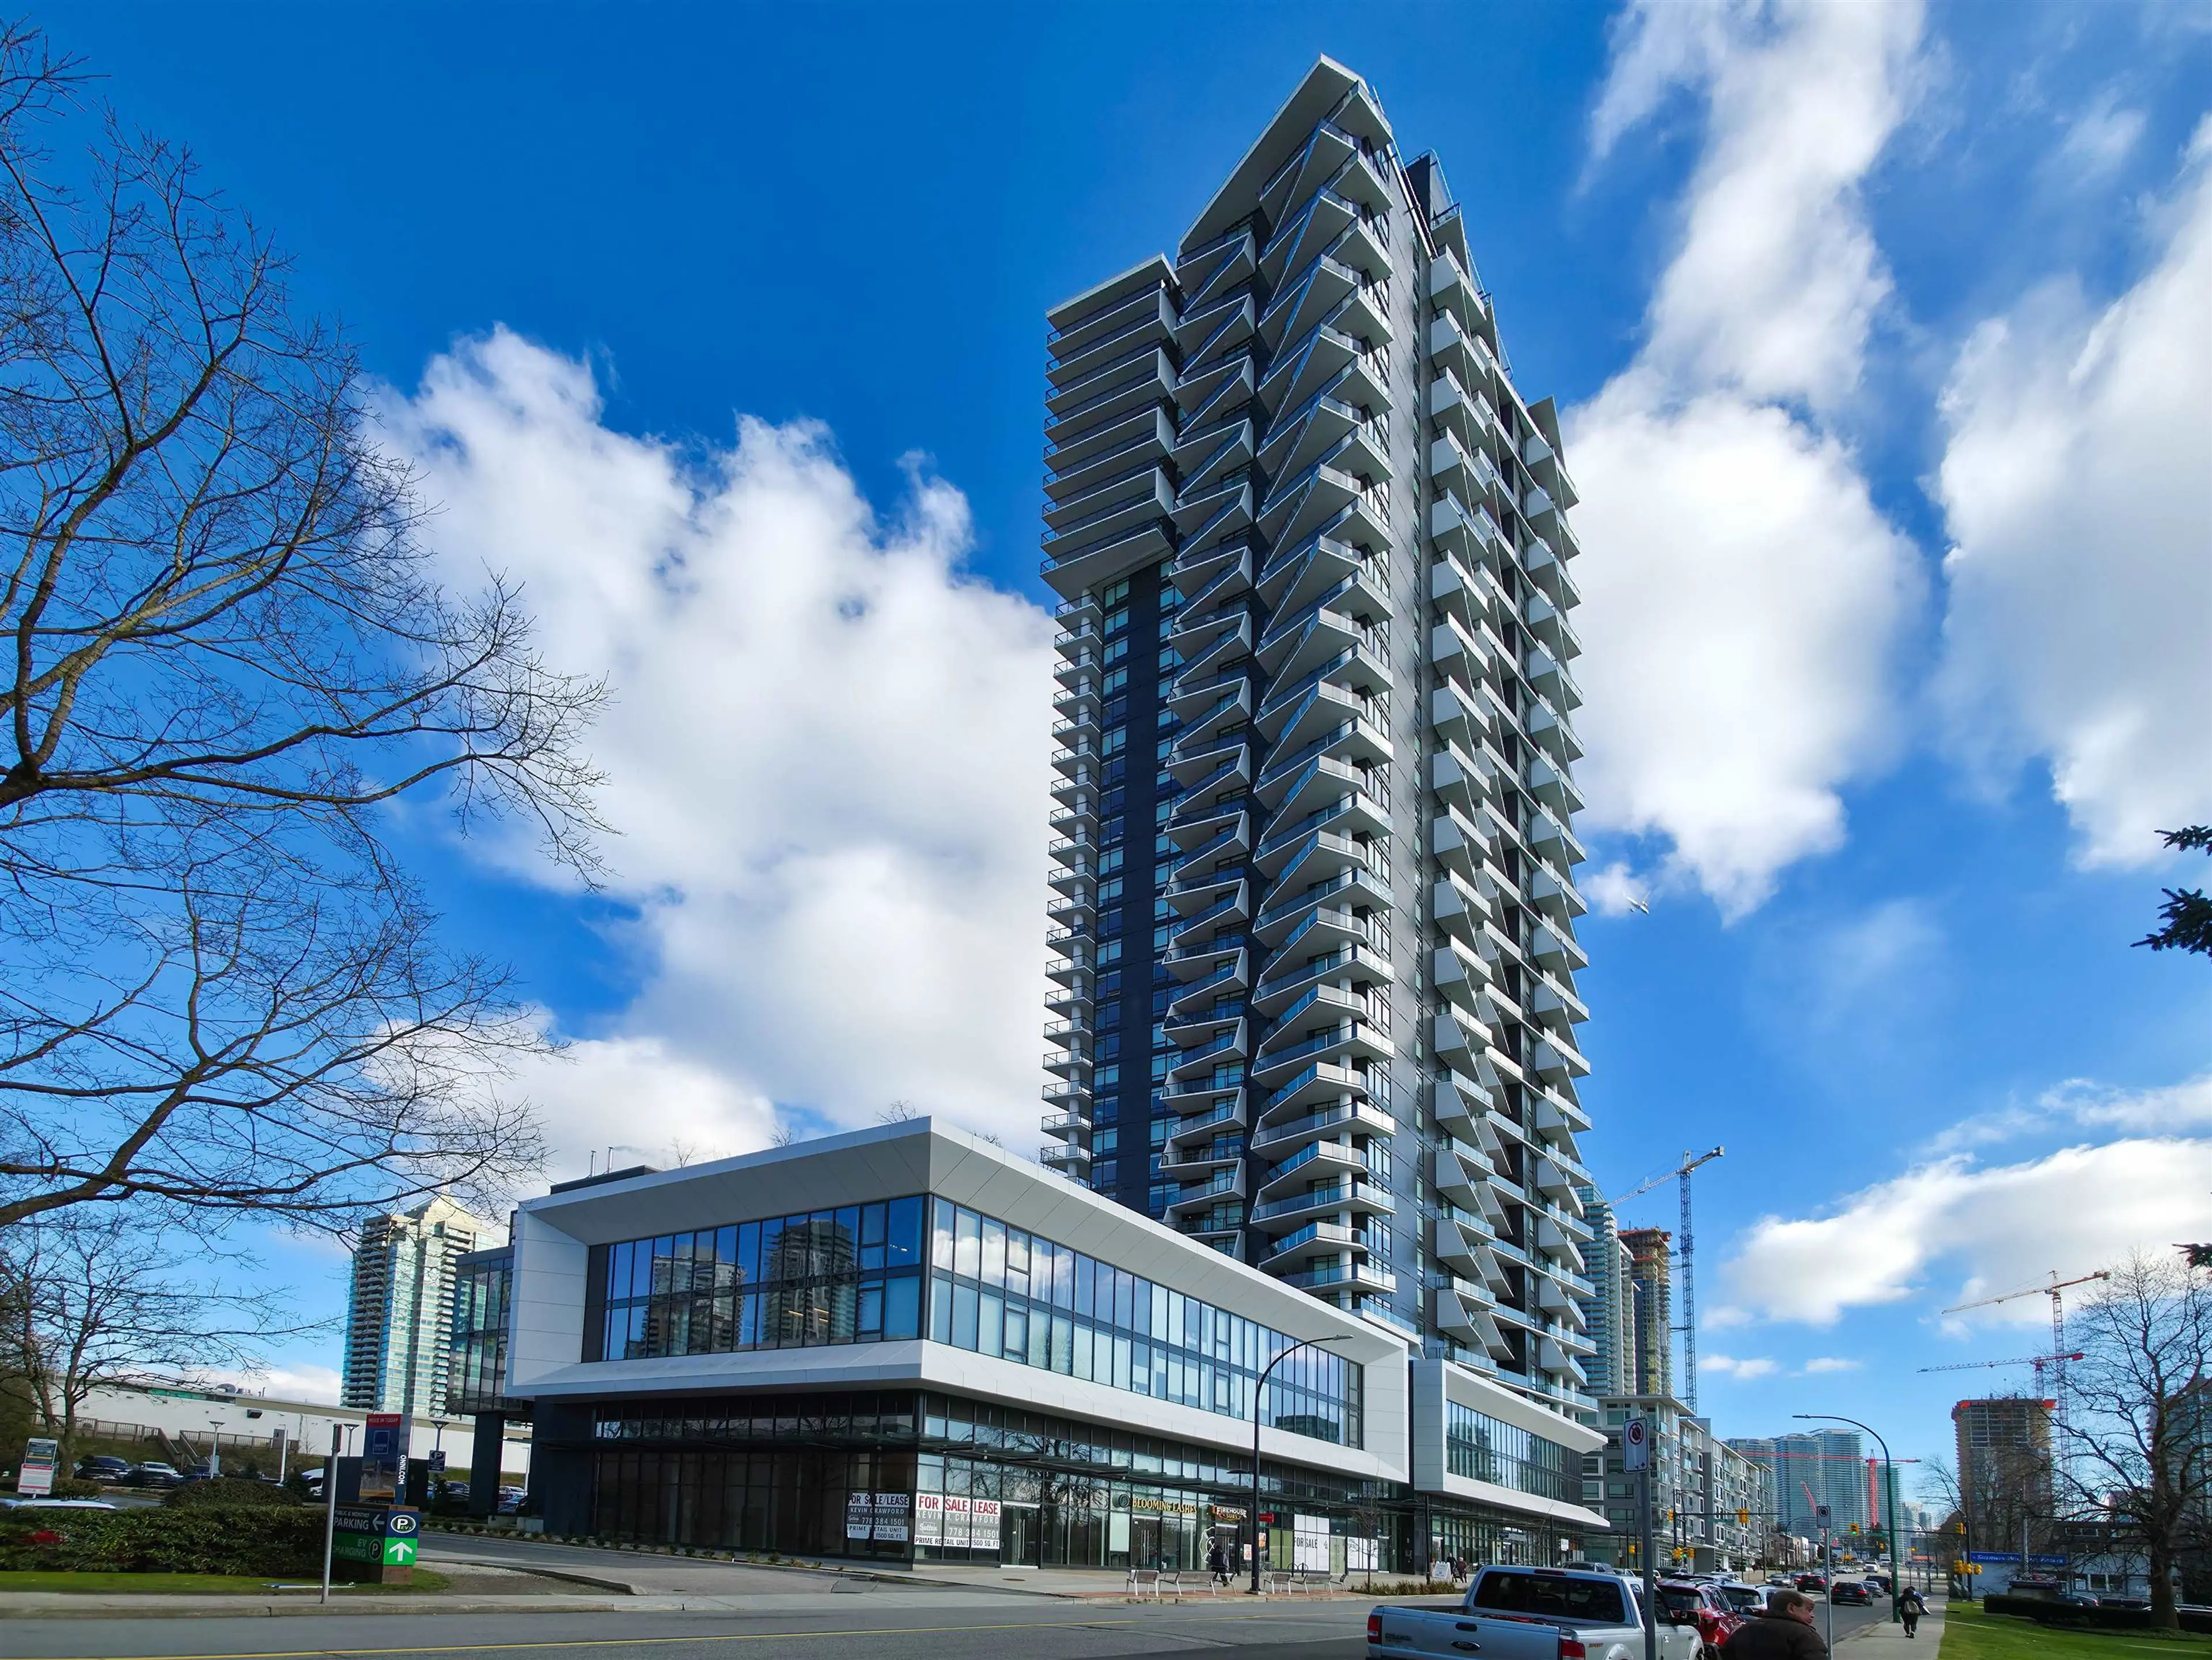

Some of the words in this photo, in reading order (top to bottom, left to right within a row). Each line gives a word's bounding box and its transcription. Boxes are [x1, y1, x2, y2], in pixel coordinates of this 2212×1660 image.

[398, 1454, 407, 1485] ONNI.COM
[865, 1495, 908, 1506] SLE/LEASE
[919, 1495, 939, 1510] FOR
[1132, 1498, 1171, 1511] BLOOMING
[1172, 1502, 1197, 1514] LASHES
[916, 1510, 942, 1521] KEVIN
[955, 1514, 999, 1524] CRAWFORD
[1216, 1506, 1247, 1518] FIREHOUSE
[334, 1517, 369, 1530] PARKING
[397, 1518, 408, 1530] P
[891, 1518, 904, 1526] 1501
[949, 1527, 963, 1536] 778
[965, 1528, 980, 1537] 384
[983, 1529, 999, 1538] 1501
[357, 1538, 368, 1547] EV
[1305, 1538, 1317, 1549] SALE
